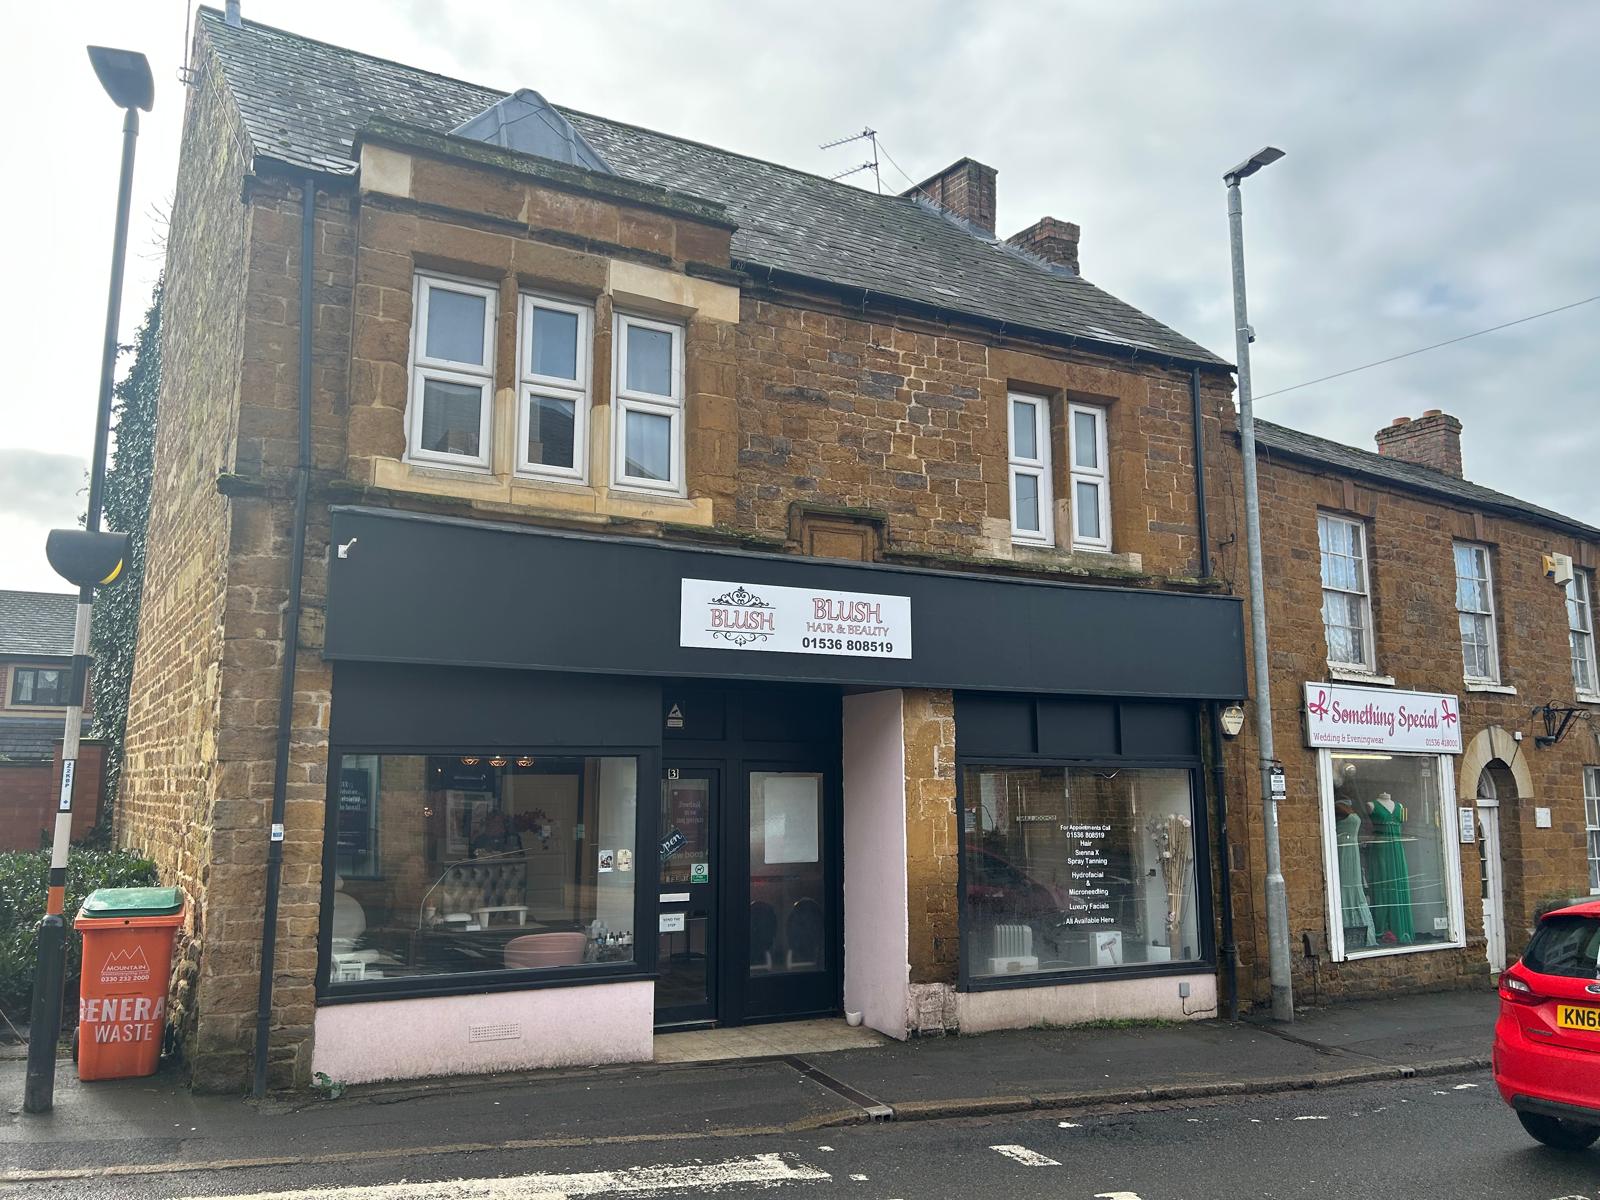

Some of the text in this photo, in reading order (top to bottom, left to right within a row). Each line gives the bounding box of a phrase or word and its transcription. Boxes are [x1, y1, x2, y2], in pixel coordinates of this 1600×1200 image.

[812, 597, 883, 624] BLUSH
[710, 608, 775, 631] BLUSH
[806, 622, 889, 637] HAIR & BEAUTY
[802, 637, 893, 653] 01536 808519
[1332, 701, 1439, 737] Something Special
[1313, 732, 1340, 744] Wedding
[1347, 734, 1384, 745] Eveningwear
[1072, 871, 1104, 879] Hydrofacial
[1069, 903, 1088, 911] Luxury
[95, 1024, 154, 1042] WASTE
